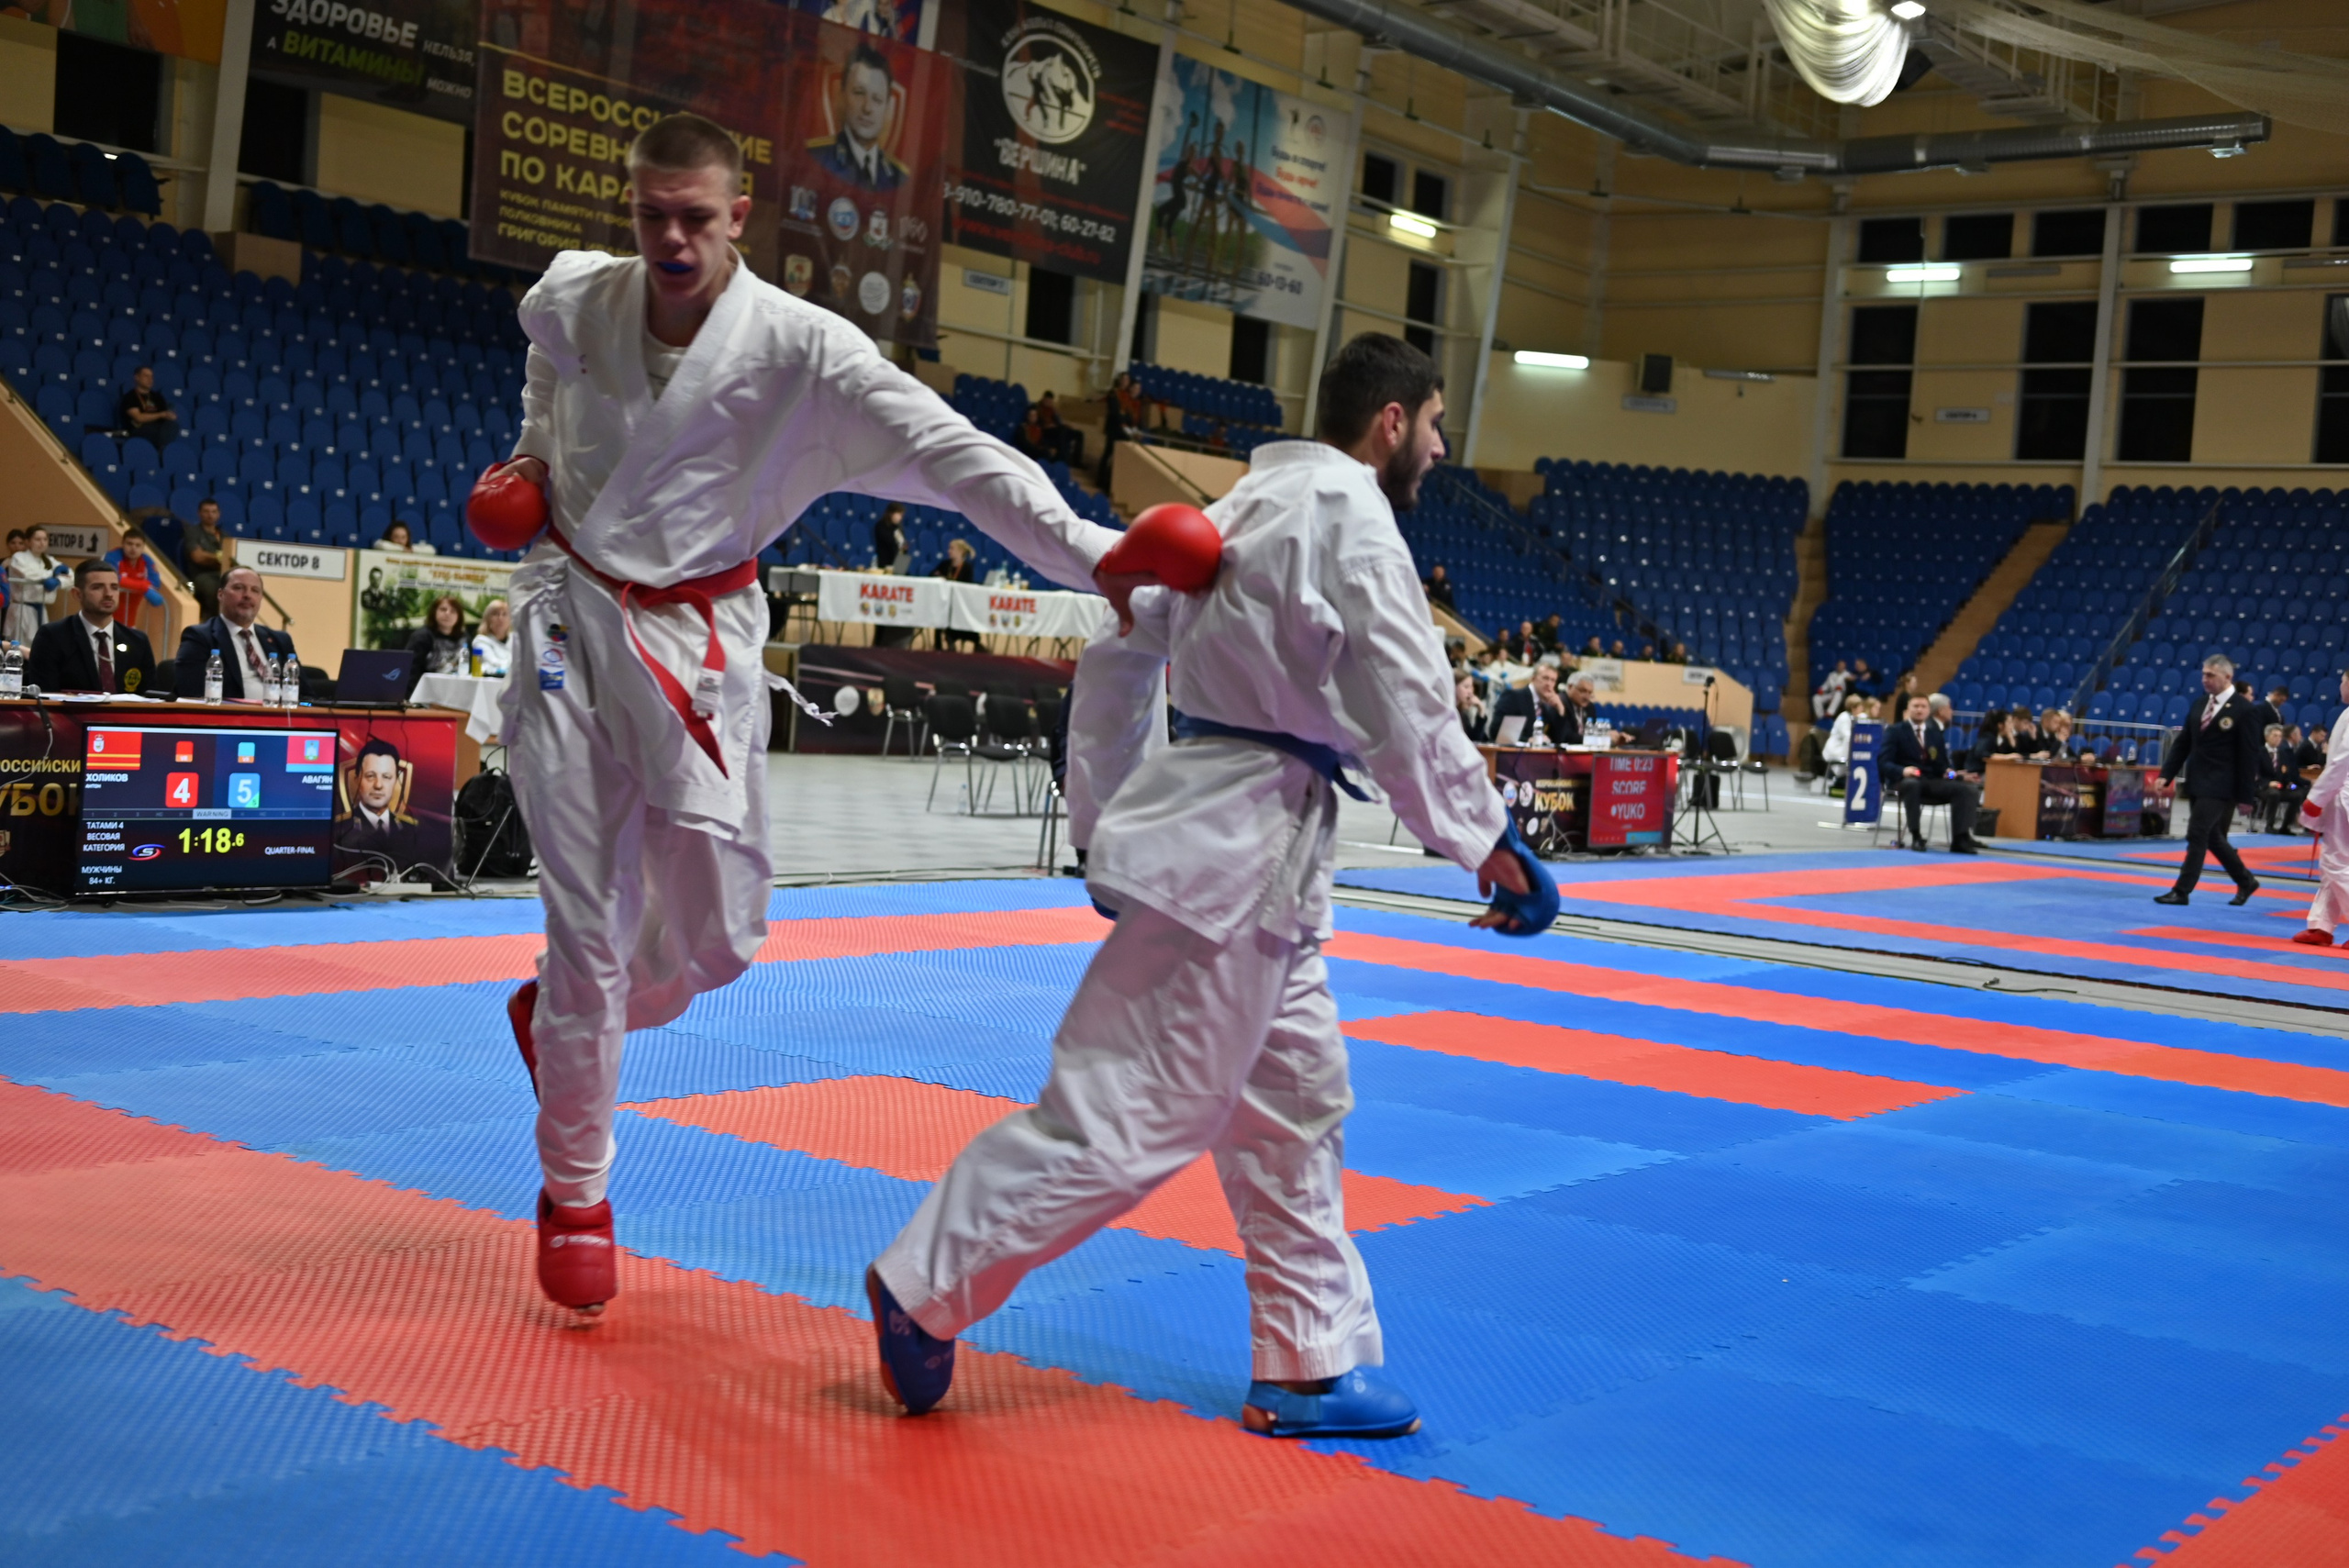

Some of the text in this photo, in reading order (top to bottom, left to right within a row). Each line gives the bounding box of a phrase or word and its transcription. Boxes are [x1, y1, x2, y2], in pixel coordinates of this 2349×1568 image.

[266, 36, 277, 50] А
[282, 29, 427, 86] ВИТАМИНЫ
[501, 149, 546, 184] ПО
[48, 533, 84, 549] ЕКТОР 8
[258, 551, 320, 570] СЕКТОР 8
[860, 583, 914, 603] KARATE
[989, 595, 1038, 614] KARATE
[0, 757, 81, 773] ОССИЙСКИ
[85, 773, 128, 782] ХОЛИКОВ
[302, 775, 333, 784] АВАГЯН
[173, 778, 191, 804] 4
[237, 779, 251, 804] 5
[1850, 765, 1867, 811] 2
[1534, 792, 1575, 813] КУБОК
[86, 821, 125, 829] ТАТАМИ 4
[86, 832, 121, 840] ВЕСОВАЯ
[83, 843, 126, 852] КАТЕГОРИЯ
[264, 846, 316, 856] QUARTER-FINAL
[81, 865, 123, 874] МУЖЧИНЫ
